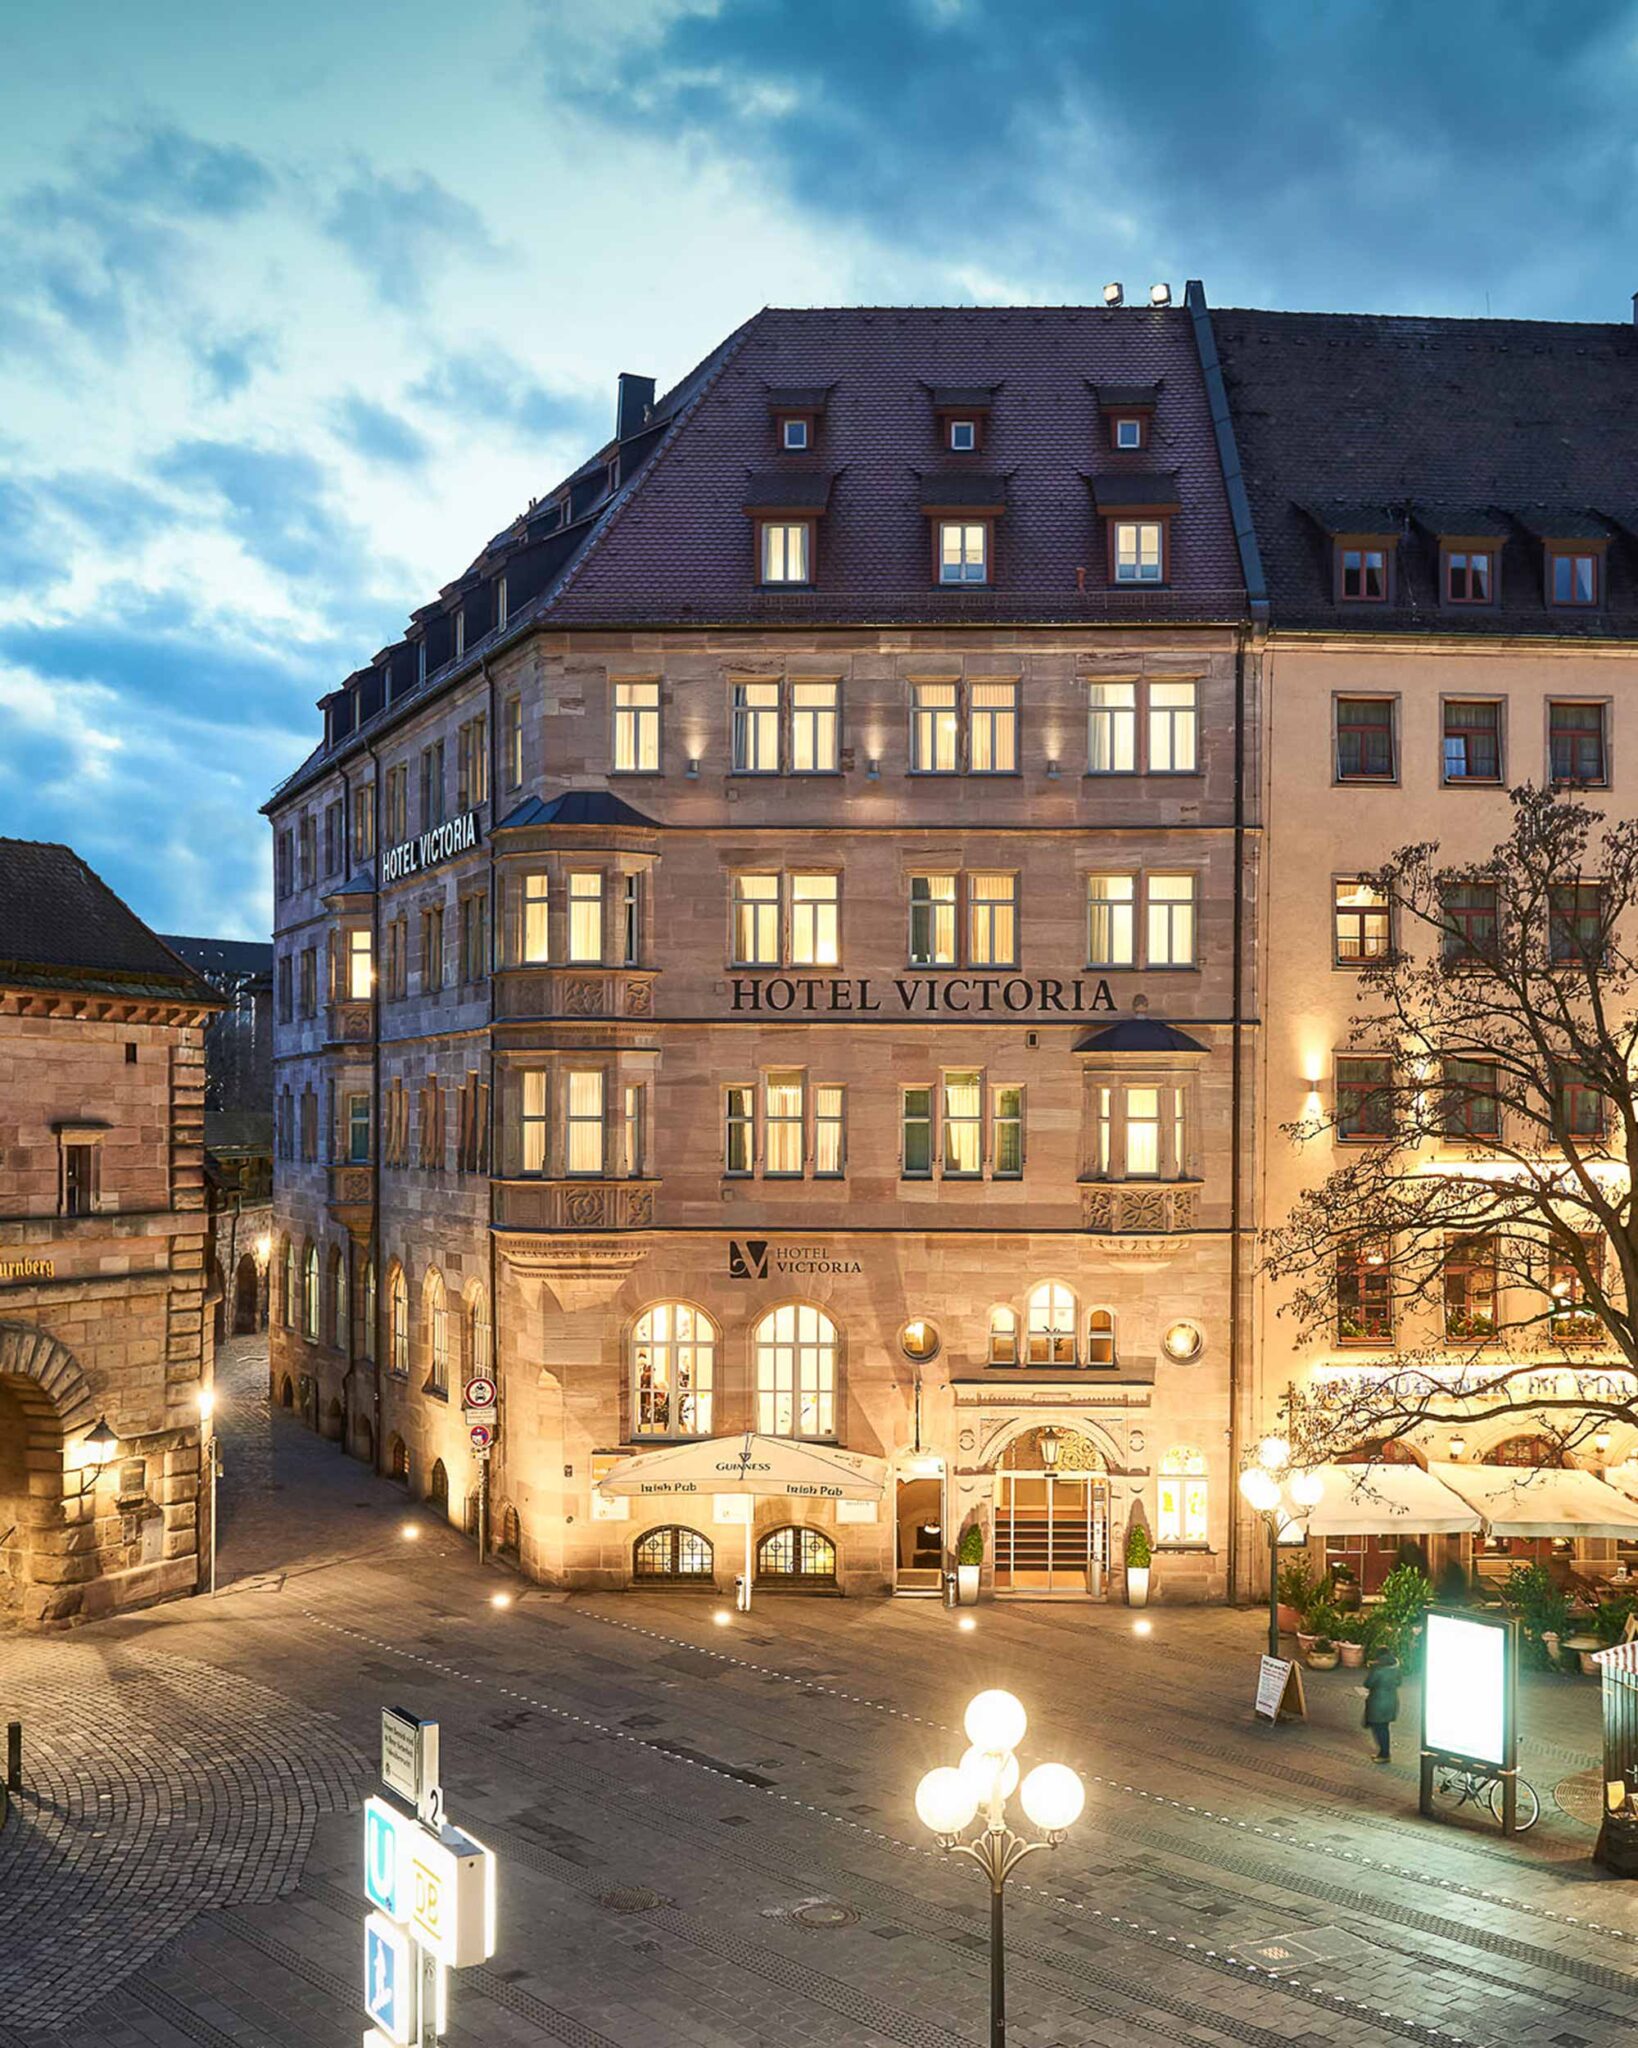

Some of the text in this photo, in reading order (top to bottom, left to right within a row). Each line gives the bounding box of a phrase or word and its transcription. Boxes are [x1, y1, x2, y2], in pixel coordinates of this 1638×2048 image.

[382, 811, 476, 883] HOTEL VICTORIA
[731, 979, 1118, 1012] HOTEL VICTORIA
[776, 1247, 830, 1259] HOTEL
[776, 1261, 862, 1273] VICTORIA
[715, 1461, 771, 1472] GUINNESS
[640, 1482, 697, 1493] Irish Pub
[786, 1484, 843, 1497] Irish Pub
[369, 1815, 394, 1899] U
